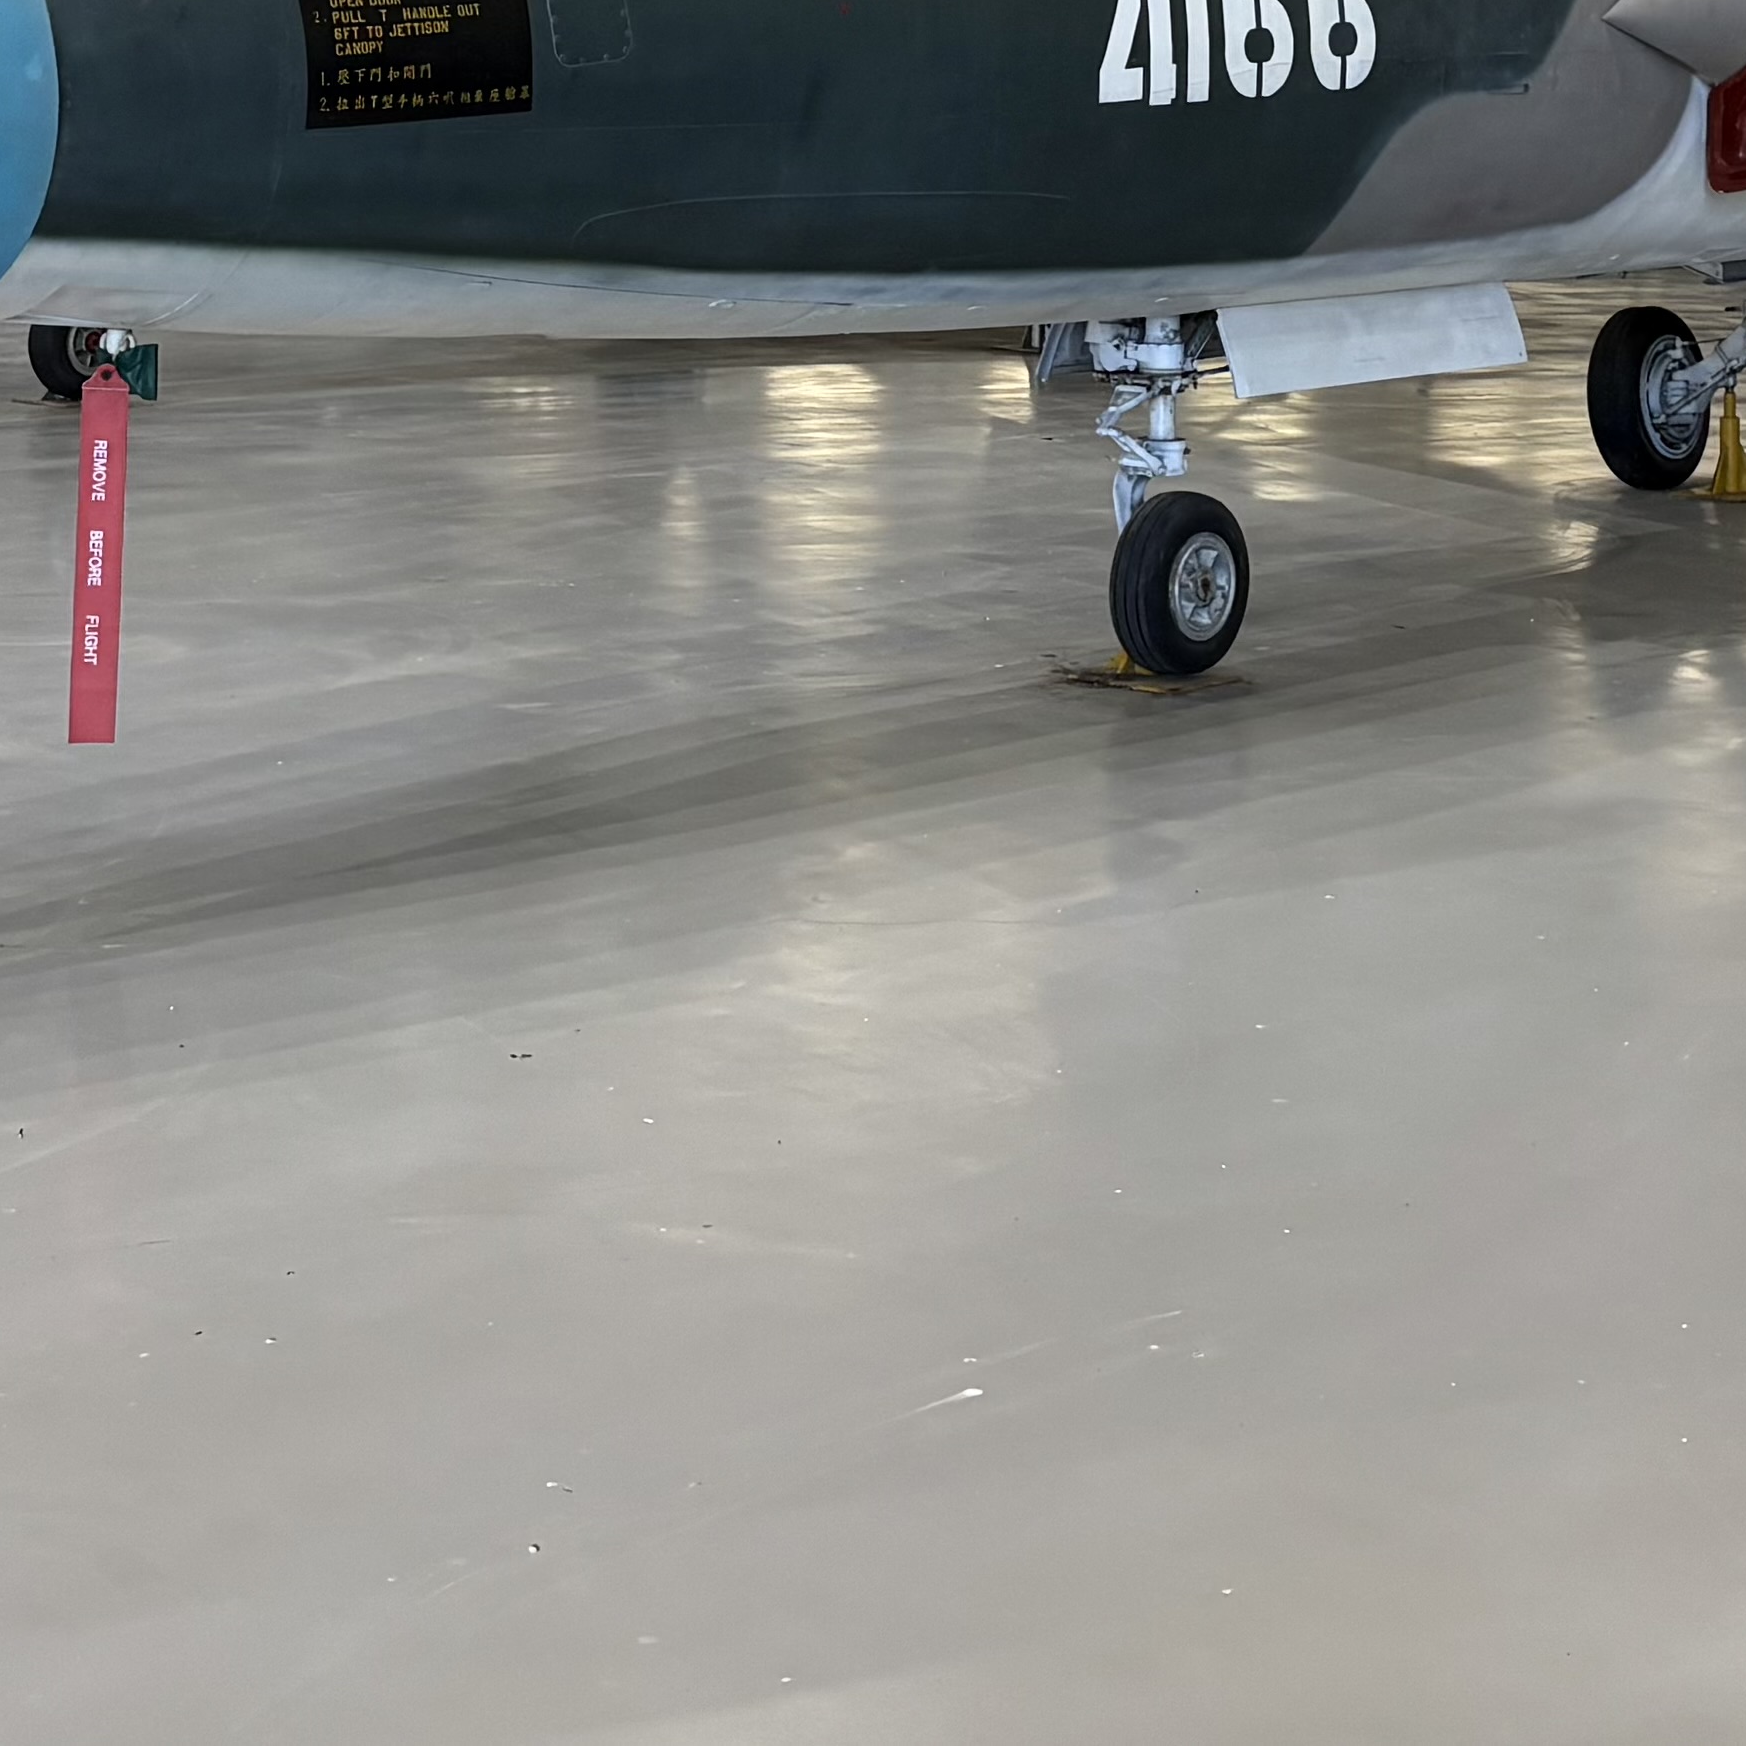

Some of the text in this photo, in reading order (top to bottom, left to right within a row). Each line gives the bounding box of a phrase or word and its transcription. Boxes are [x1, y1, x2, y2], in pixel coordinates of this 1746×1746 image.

[332, 11, 366, 24] PULL
[378, 9, 387, 22] T
[402, 5, 452, 21] HANDLE
[457, 3, 481, 17] OUT
[333, 21, 449, 40] 6FT TO JETTISON
[335, 41, 384, 56] CANOPY
[91, 439, 108, 502] REMOVE
[87, 530, 104, 586] BEFORE
[83, 614, 99, 665] FLIGHT
